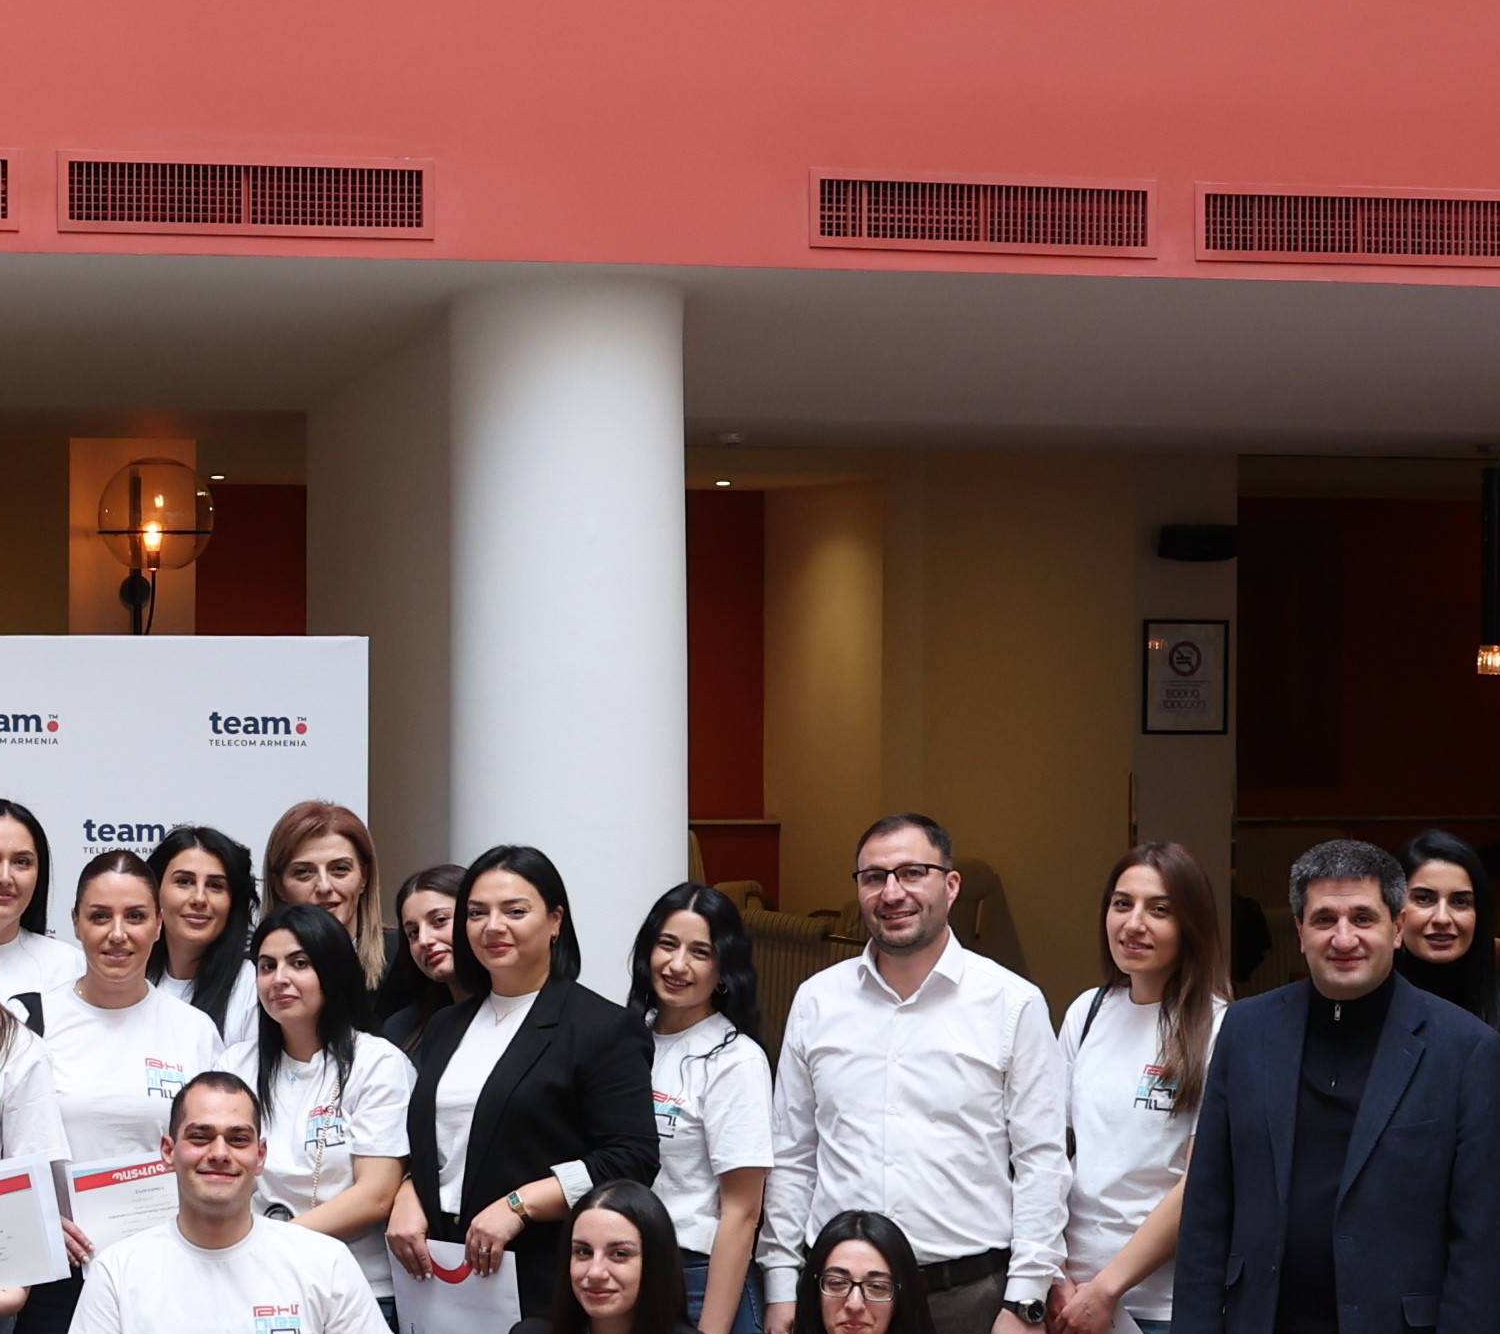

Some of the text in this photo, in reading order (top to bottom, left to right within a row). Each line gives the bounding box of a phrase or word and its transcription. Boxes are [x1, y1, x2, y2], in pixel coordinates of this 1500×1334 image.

[209, 711, 291, 735] team
[10, 737, 59, 745] ARMENIA
[209, 739, 307, 747] TELECOM ARMENIA
[83, 819, 166, 842] team
